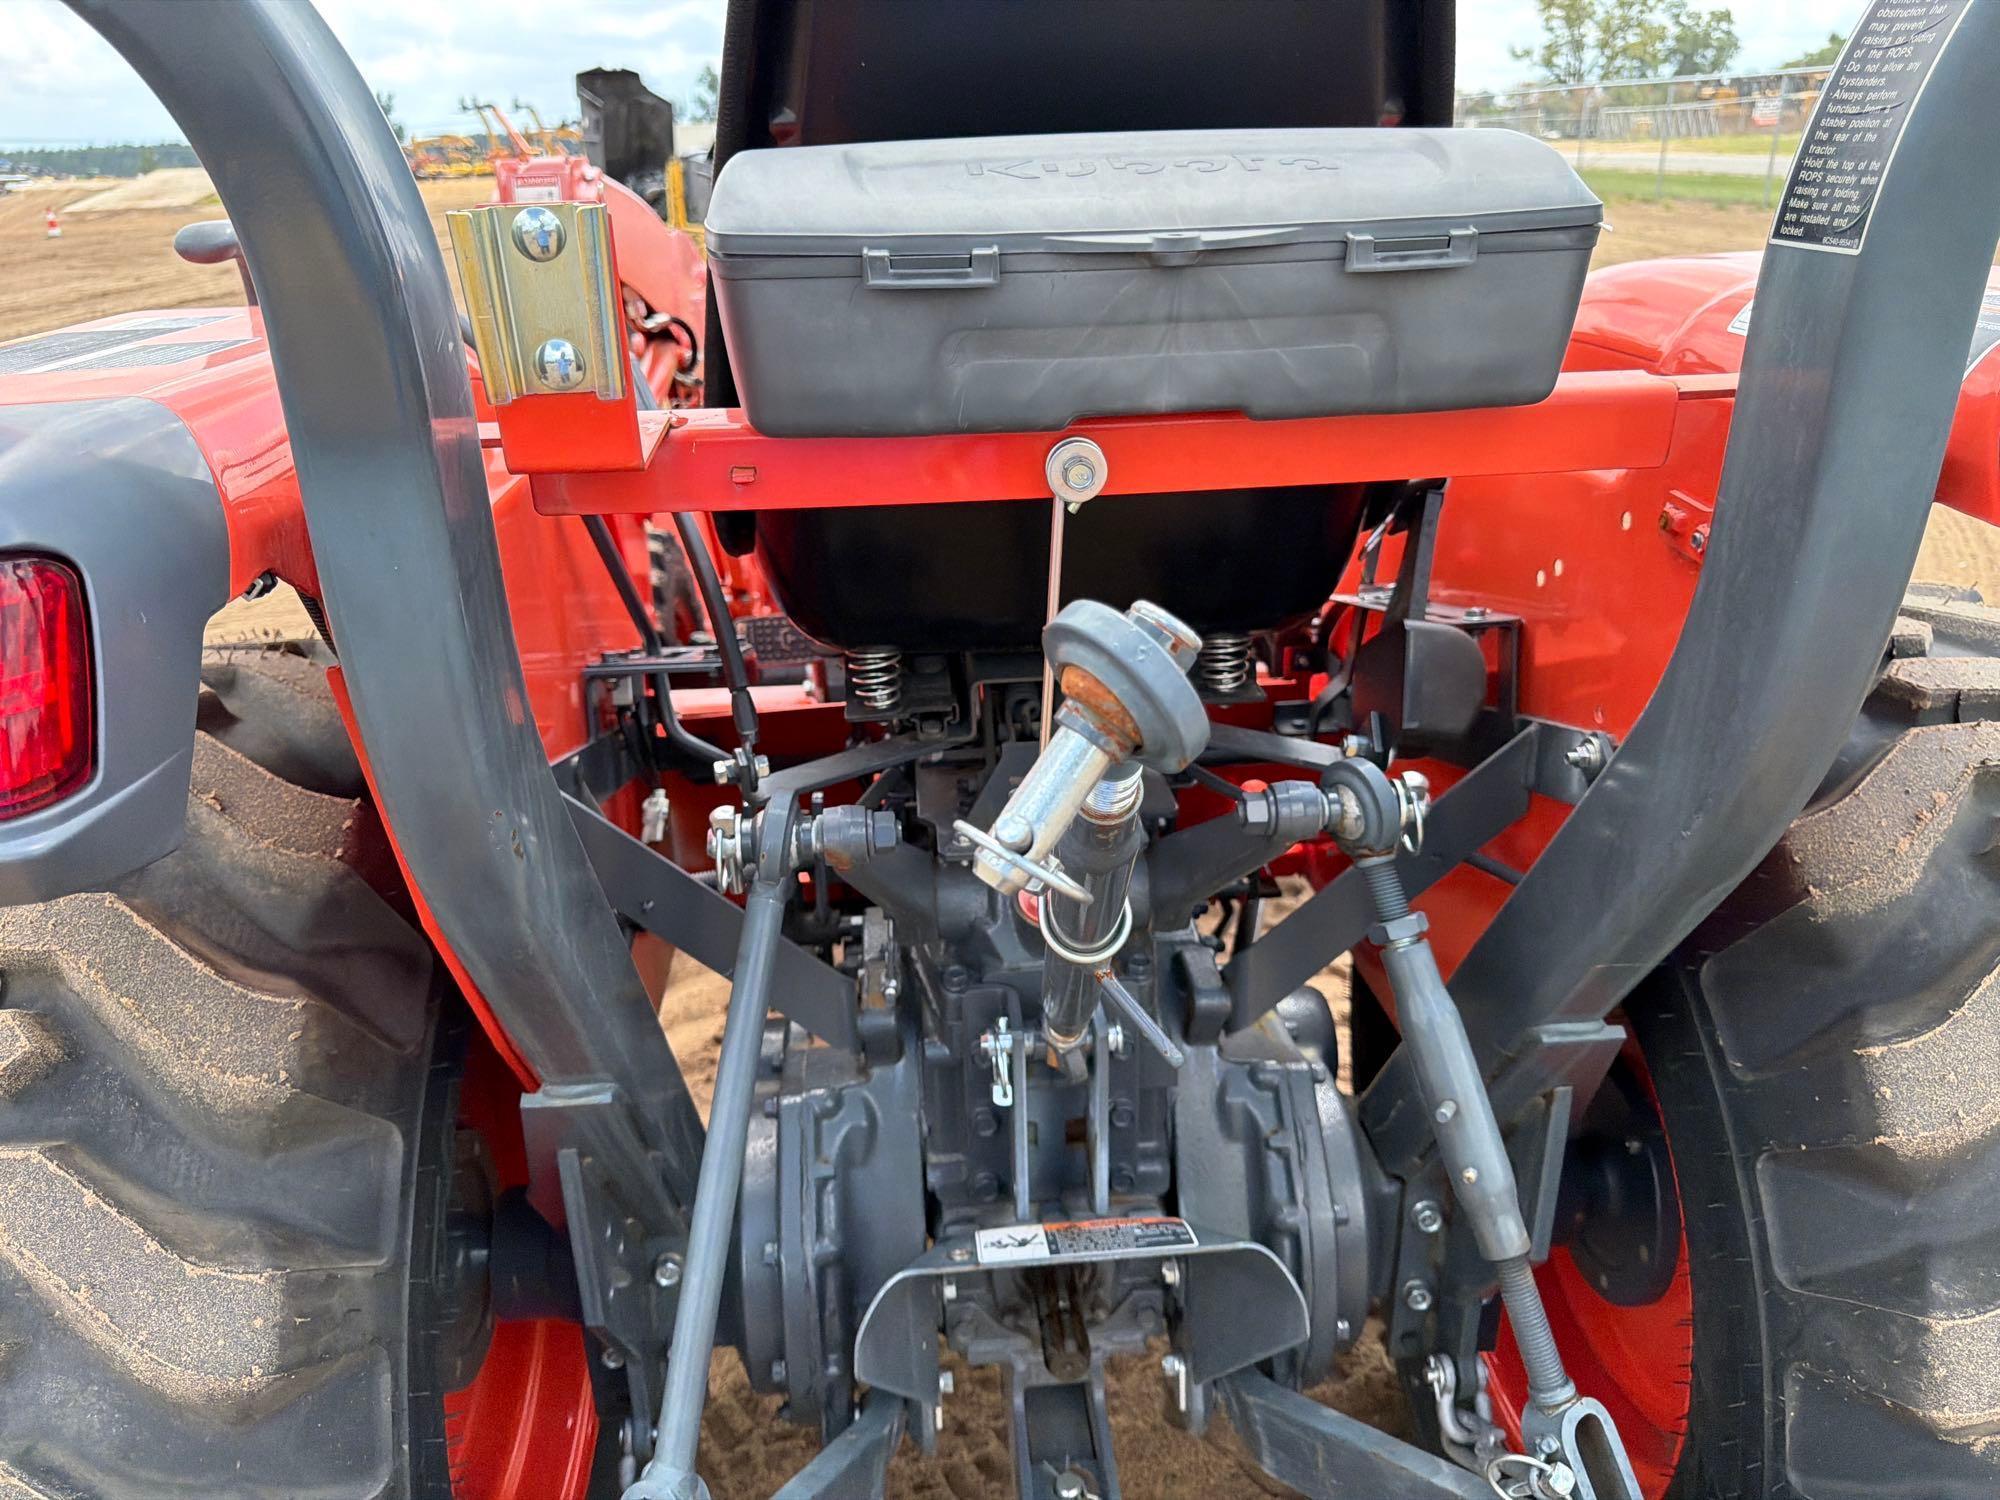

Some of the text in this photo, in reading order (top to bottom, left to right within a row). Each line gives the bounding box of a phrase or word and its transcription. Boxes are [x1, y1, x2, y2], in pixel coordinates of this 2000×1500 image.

[1876, 5, 1947, 18] obstruction that
[1868, 20, 1926, 33] may prevent
[1861, 36, 1891, 46] raising
[1894, 36, 1906, 44] or
[1853, 49, 1864, 59] of
[1868, 48, 1882, 58] the
[1865, 62, 1878, 72] not
[1881, 62, 1903, 72] allow
[1907, 62, 1920, 72] any
[1839, 76, 1887, 88] bystanders.
[1865, 90, 1898, 101] perform
[1826, 102, 1860, 113] function
[1820, 117, 1892, 130] stable position at
[1814, 130, 1877, 142] the rear of the
[1808, 144, 1836, 155] tractor.
[1826, 158, 1838, 169] the
[1841, 160, 1855, 171] top
[1857, 160, 1867, 170] of
[1868, 161, 1880, 171] the
[1798, 170, 1879, 187] ROPS securely when
[1793, 185, 1860, 201] raising or folding.
[1811, 201, 1828, 211] sure
[1831, 201, 1842, 212] all
[1843, 204, 1860, 215] pins
[1784, 212, 1849, 227] are installed and
[1780, 225, 1804, 237] locked.
